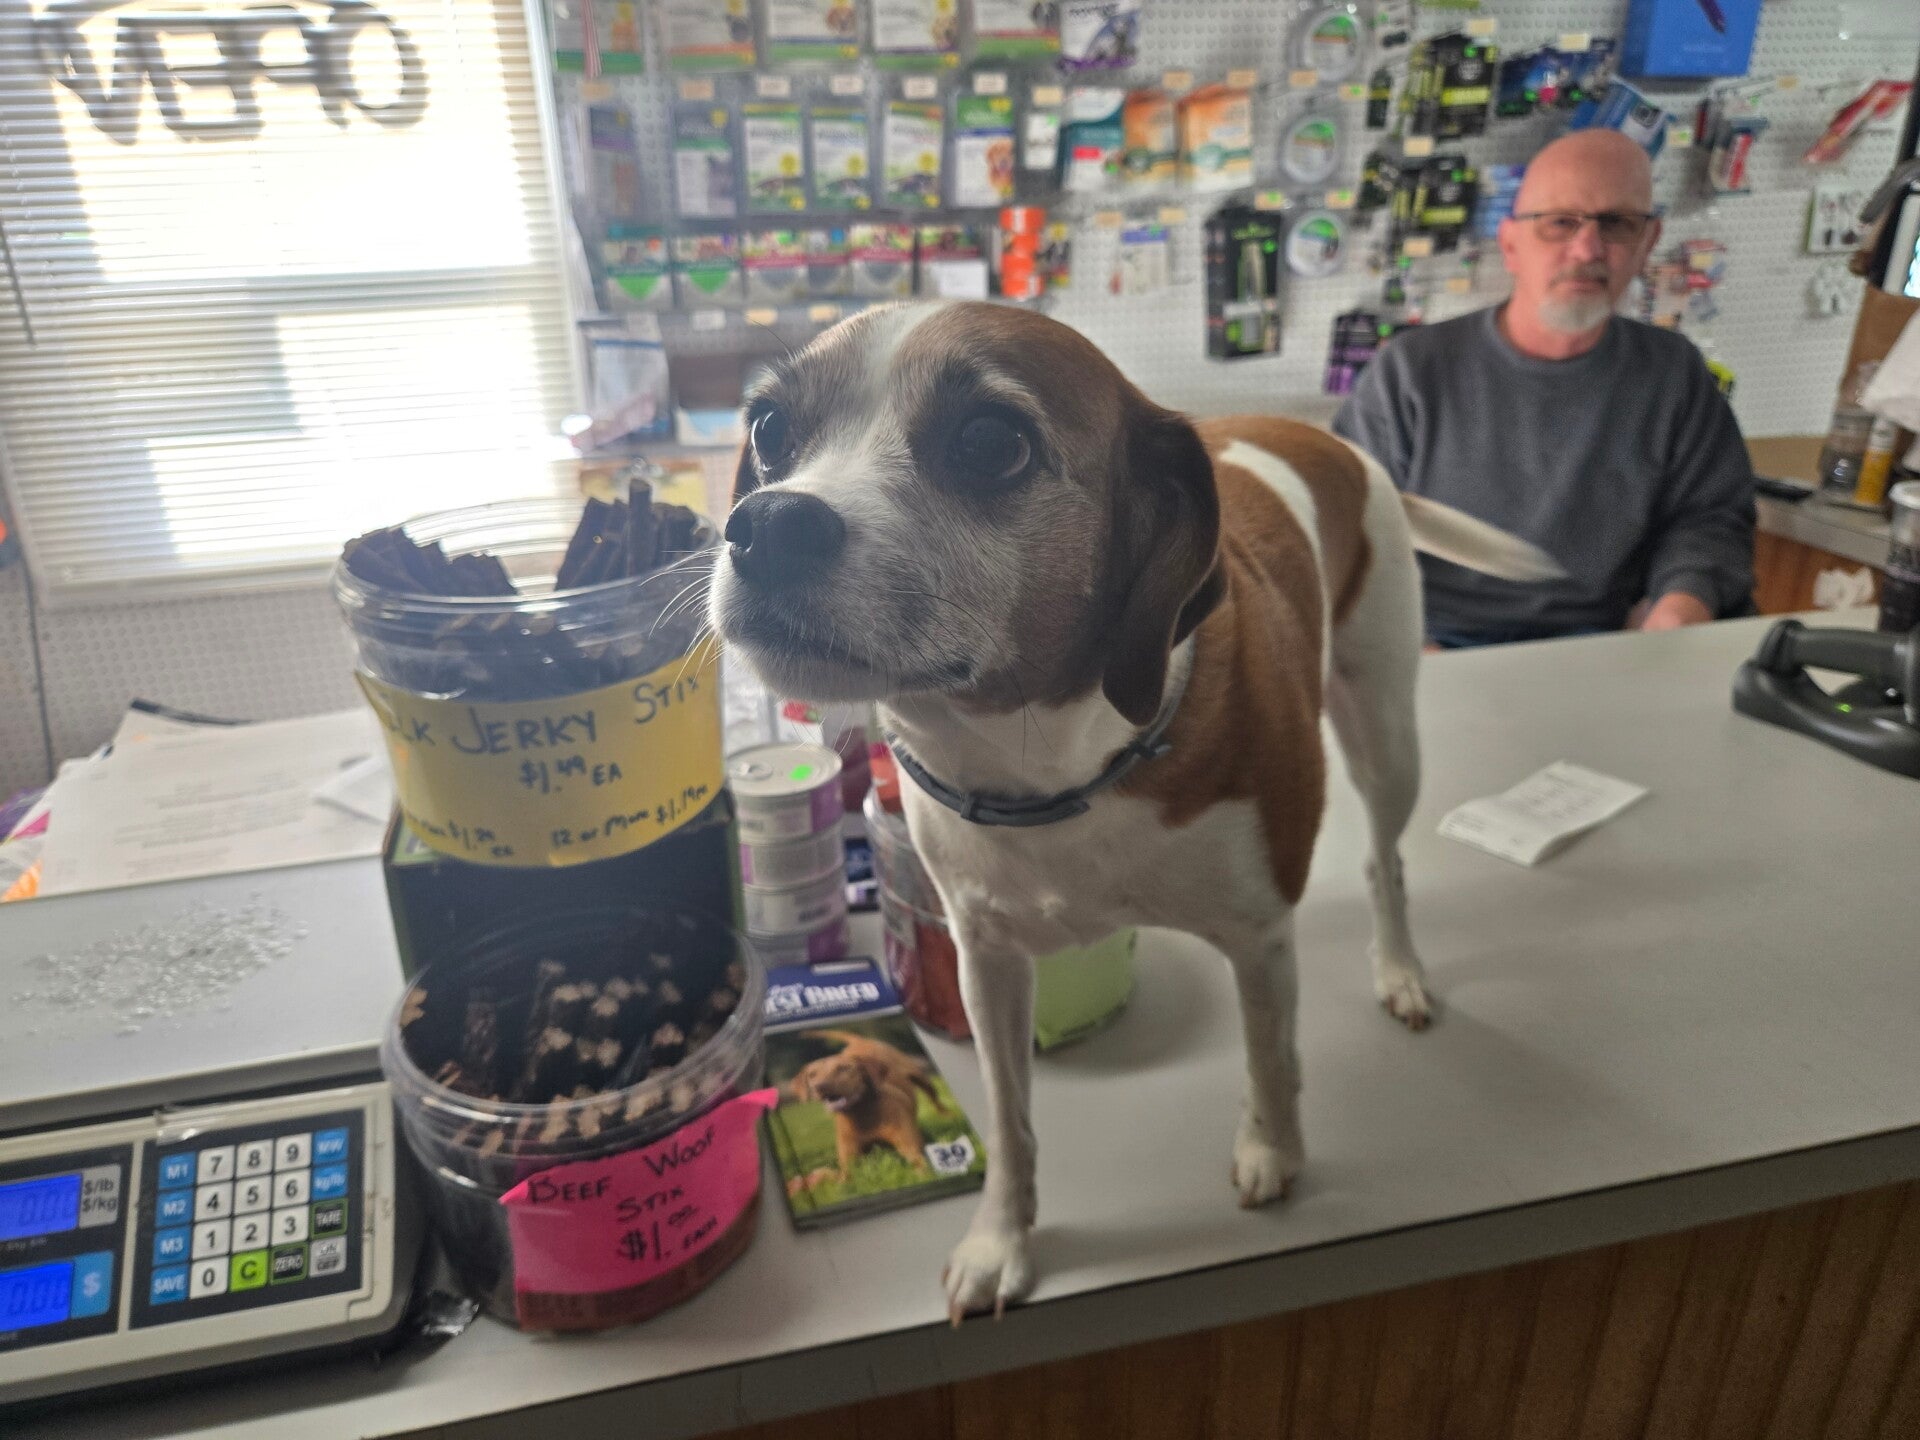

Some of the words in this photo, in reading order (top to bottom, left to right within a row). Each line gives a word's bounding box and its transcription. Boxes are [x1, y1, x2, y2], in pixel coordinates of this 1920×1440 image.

[451, 706, 597, 755] JERKY
[247, 1149, 261, 1168] 8
[286, 1143, 299, 1162] 9
[166, 1163, 189, 1180] M1
[210, 1155, 223, 1175] 7
[247, 1185, 259, 1205] 5
[285, 1179, 298, 1198] 6
[527, 1176, 612, 1204] BEEF
[163, 1199, 187, 1217] M2
[206, 1192, 219, 1211] 4
[244, 1223, 257, 1243] 2
[284, 1216, 296, 1236] 3
[160, 1237, 183, 1255] M3
[206, 1230, 216, 1249] 1
[240, 1260, 257, 1280] C
[274, 1254, 304, 1273] ZERO
[83, 1272, 101, 1297] $
[154, 1275, 186, 1295] SAVE
[202, 1268, 215, 1287] 0
